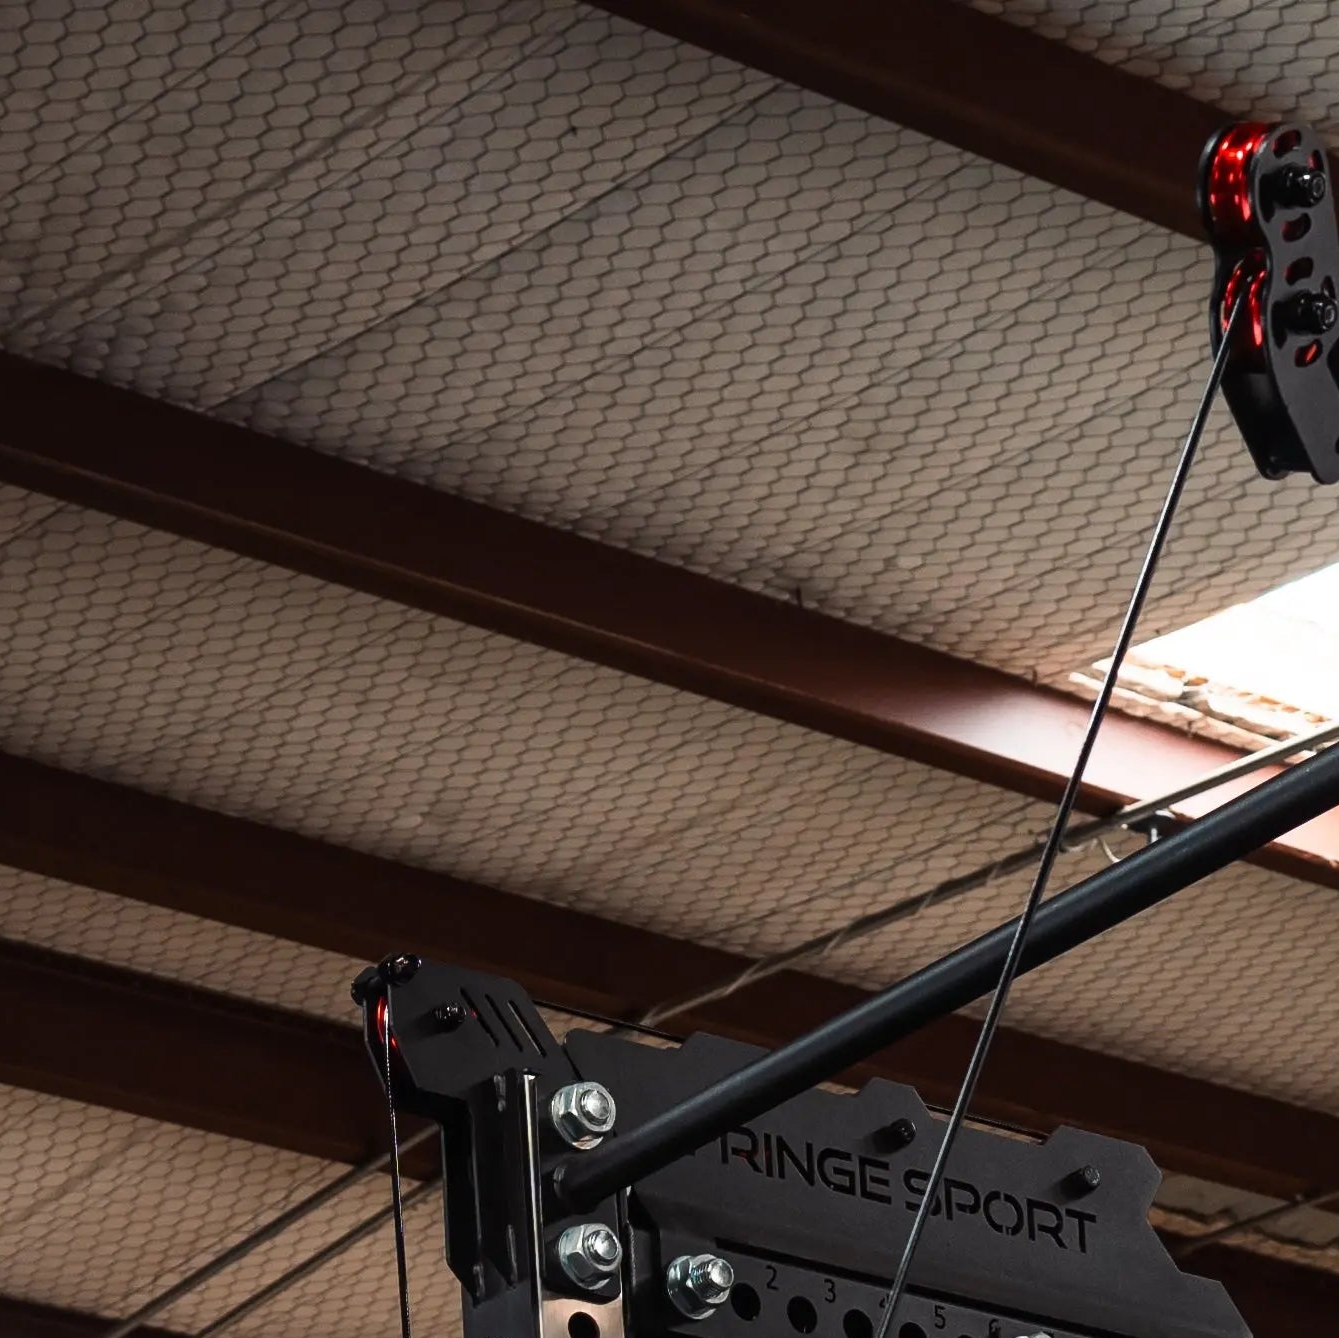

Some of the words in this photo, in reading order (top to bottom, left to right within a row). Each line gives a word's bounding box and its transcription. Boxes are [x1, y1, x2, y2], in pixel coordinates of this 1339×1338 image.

[720, 1125, 893, 1205] RINGE
[902, 1168, 1097, 1253] SPORT
[766, 1266, 779, 1290] 2
[824, 1279, 836, 1303] 3
[934, 1305, 946, 1329] 5
